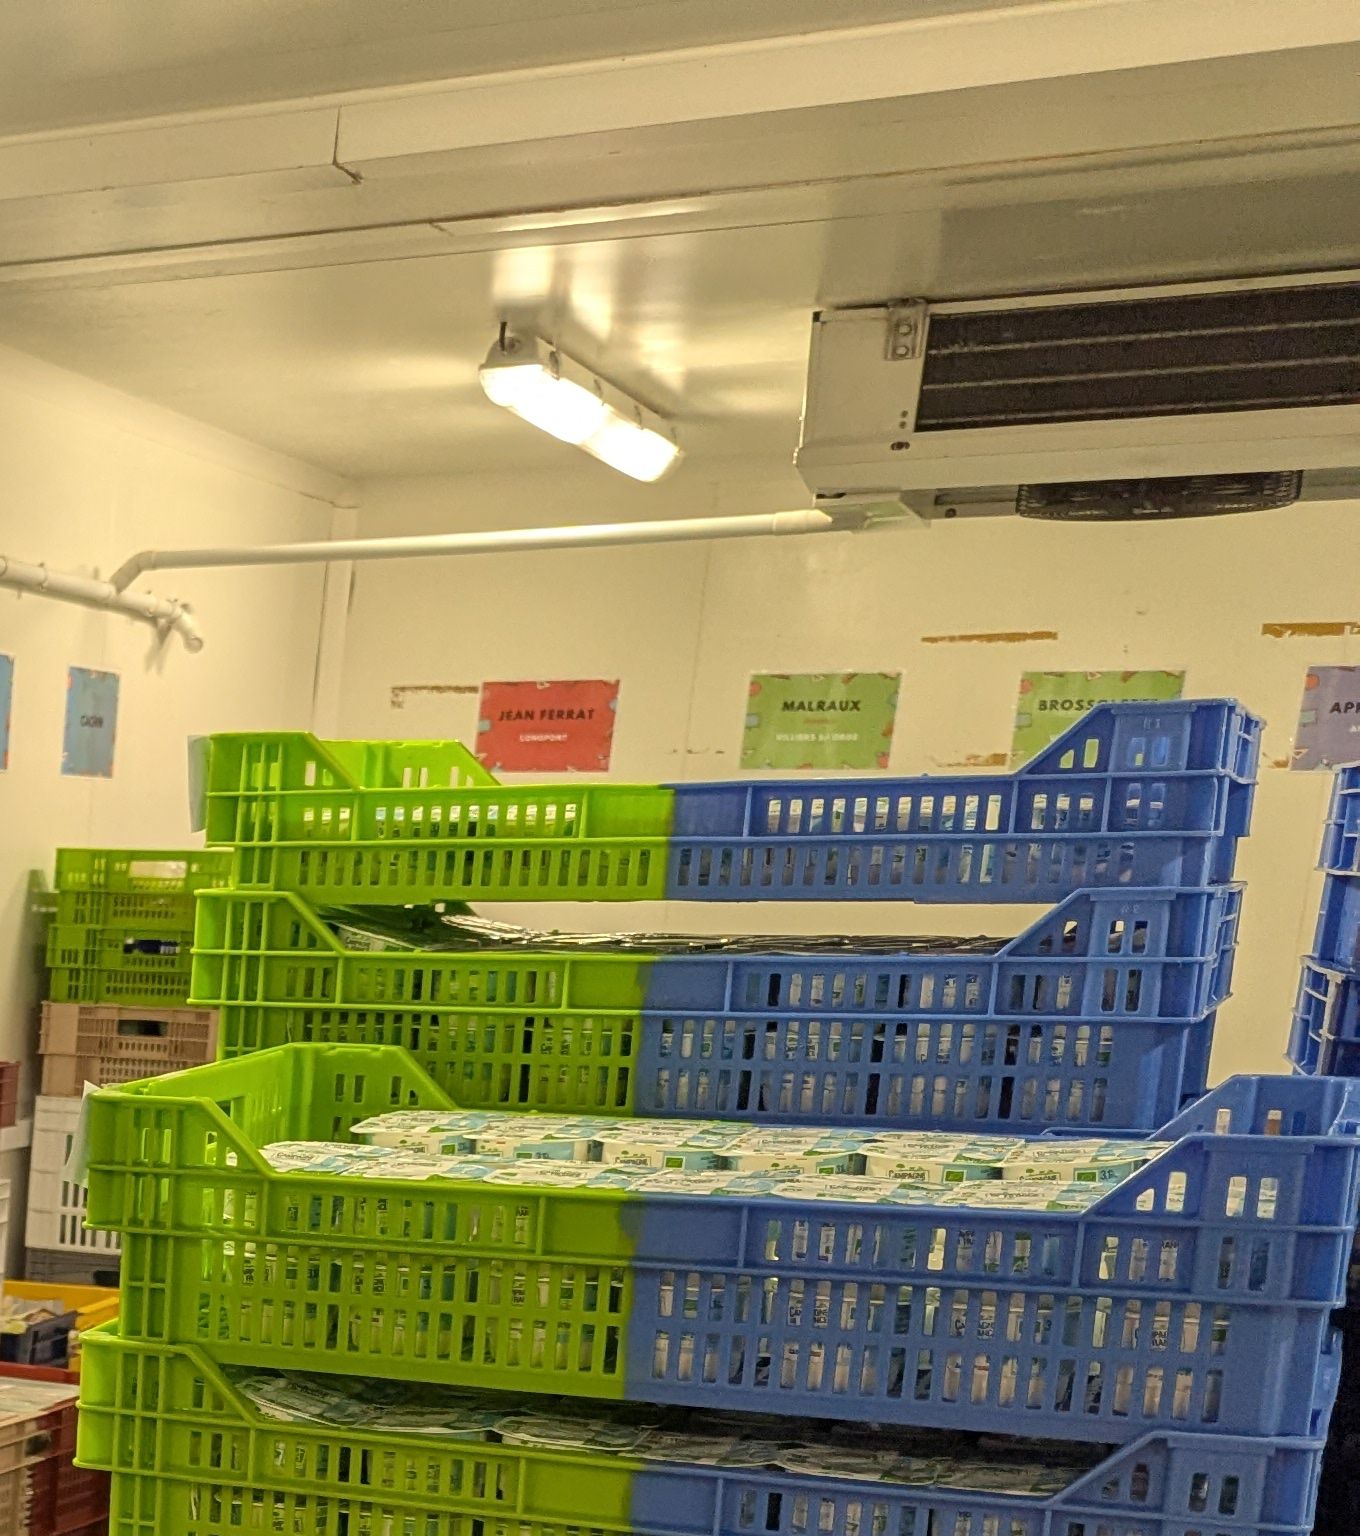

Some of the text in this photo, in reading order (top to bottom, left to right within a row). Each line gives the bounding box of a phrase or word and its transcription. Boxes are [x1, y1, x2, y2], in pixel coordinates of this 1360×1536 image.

[782, 700, 861, 711] MALRAUX
[499, 707, 595, 721] JEAN FERRAT
